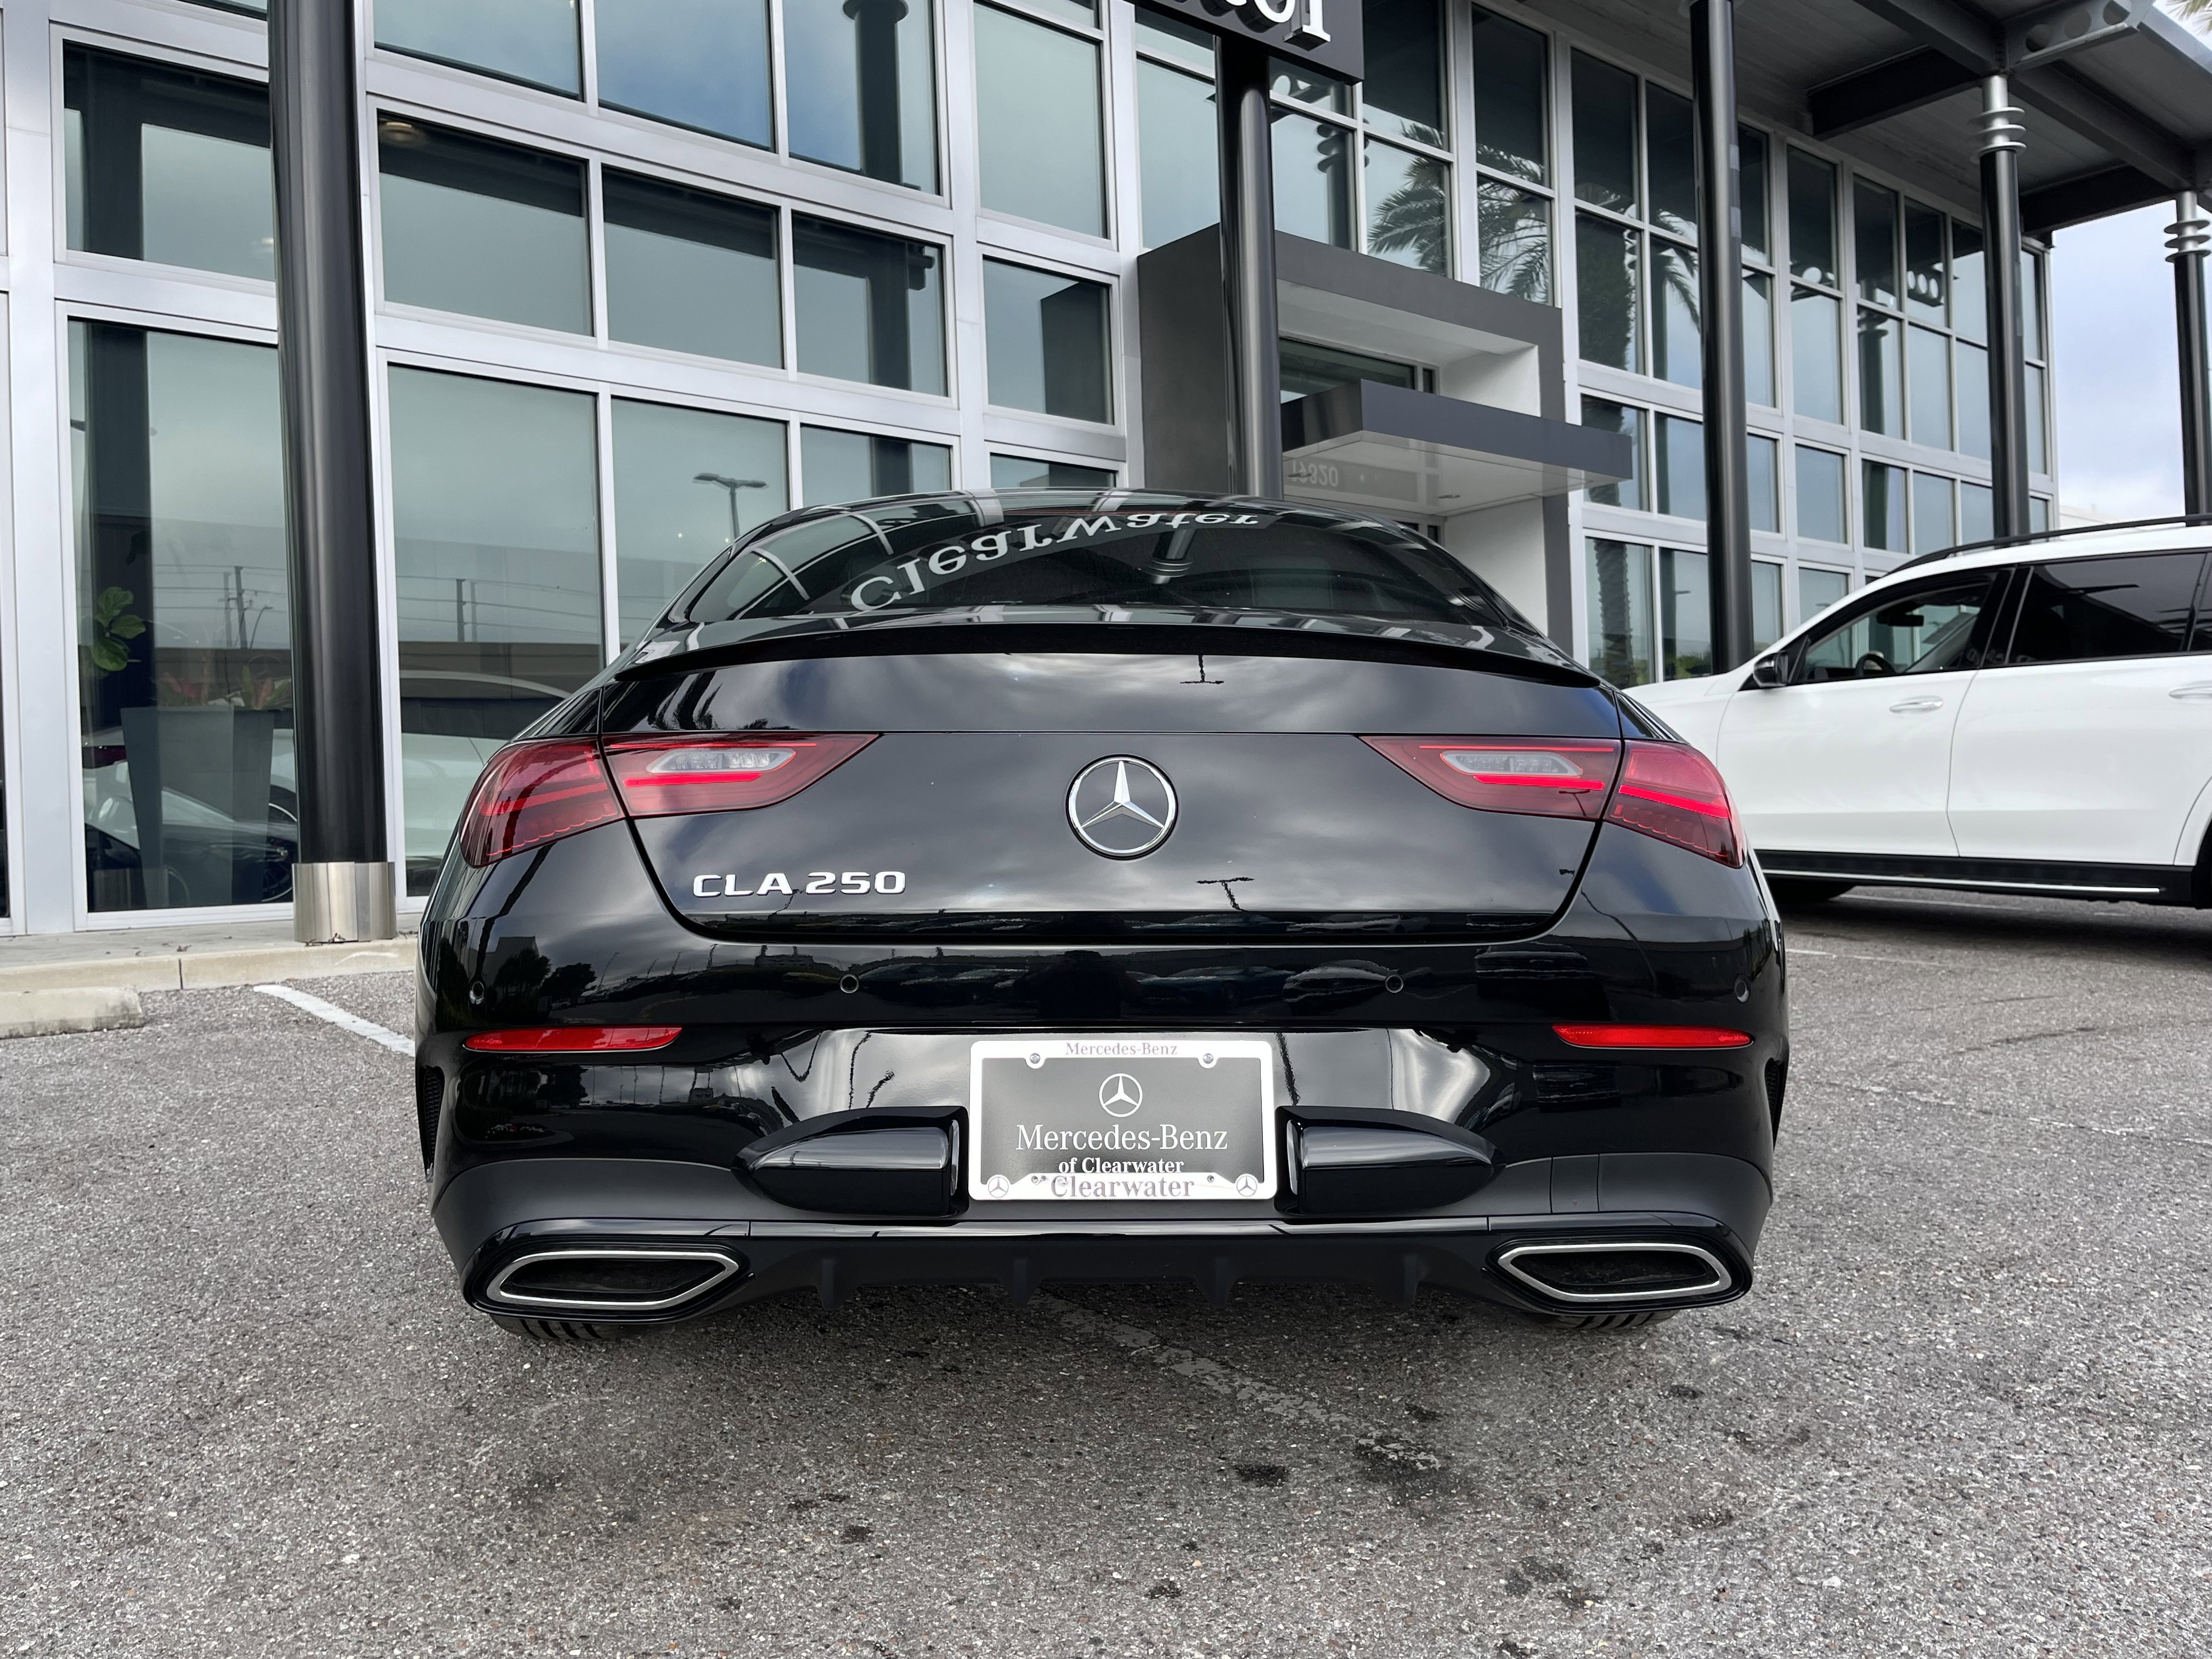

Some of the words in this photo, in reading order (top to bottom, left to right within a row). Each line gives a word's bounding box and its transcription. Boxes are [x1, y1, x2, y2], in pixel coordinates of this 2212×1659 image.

[693, 873, 793, 896] CLA
[805, 871, 906, 895] 250
[1065, 1042, 1178, 1055] Mercedes-Benz
[1015, 1124, 1228, 1151] Mercedes-Benz
[1058, 1158, 1078, 1173] of
[1081, 1157, 1184, 1173] Clearwater
[1051, 1175, 1194, 1198] Clearwater
